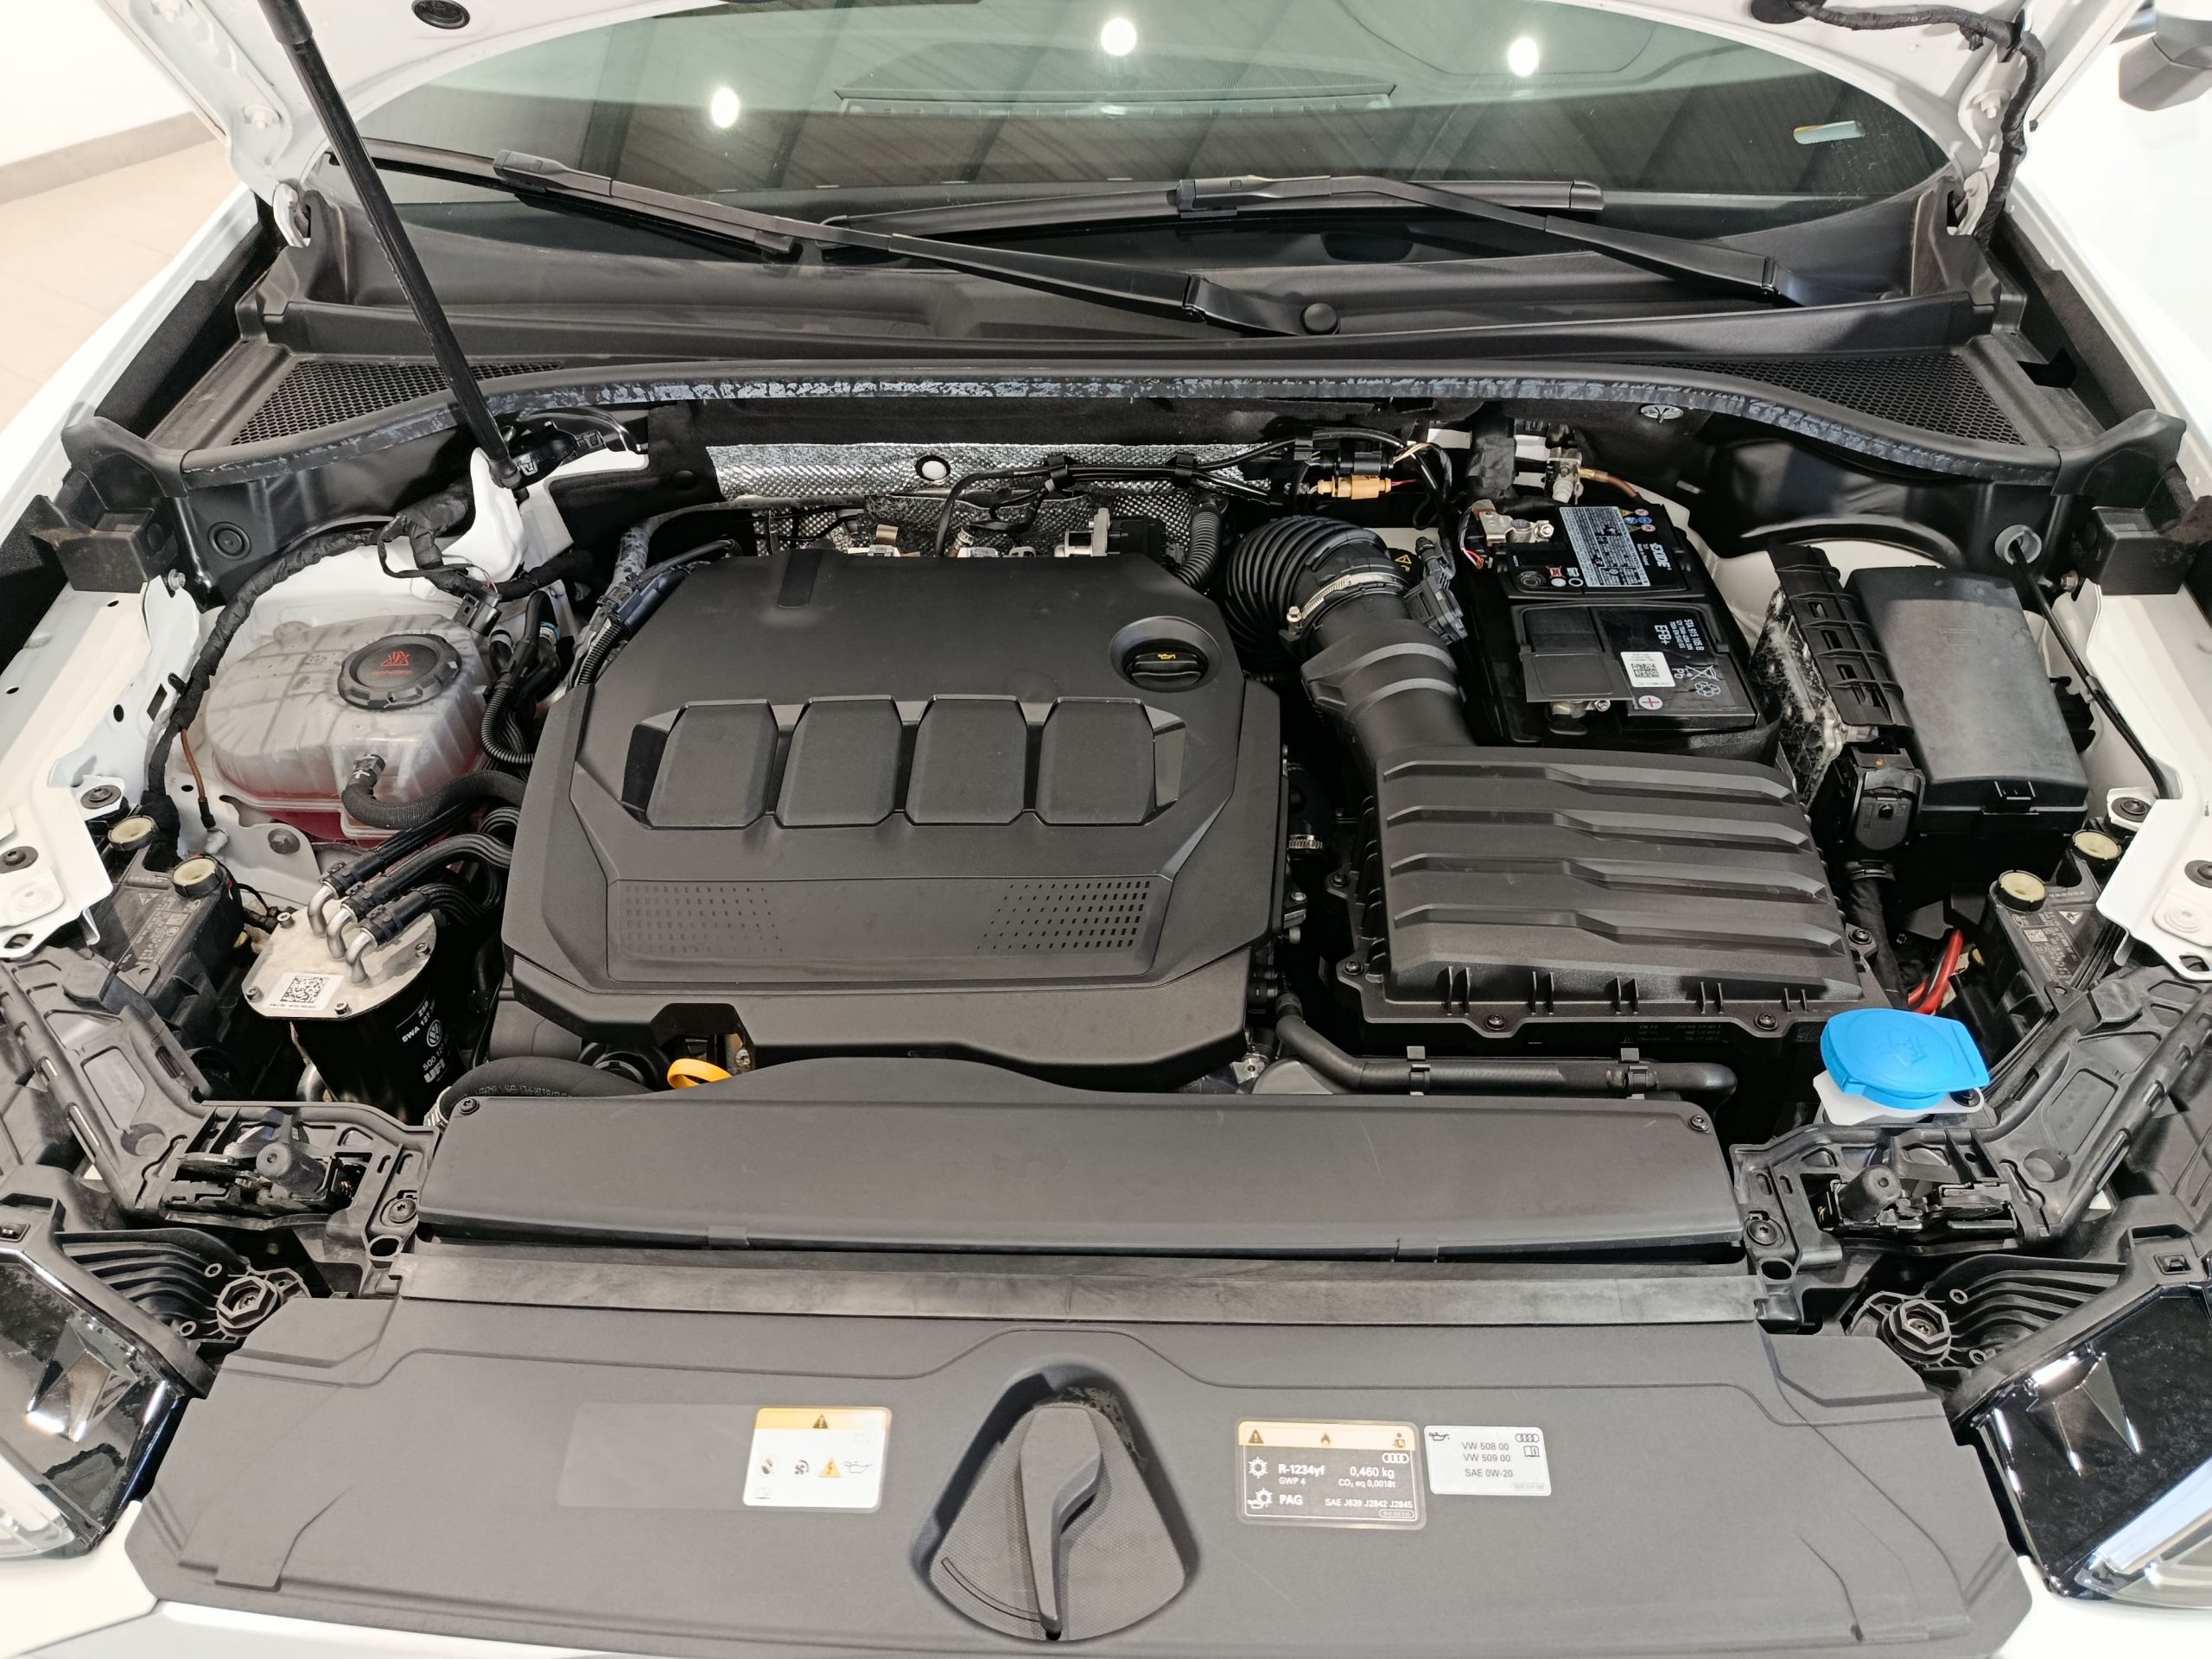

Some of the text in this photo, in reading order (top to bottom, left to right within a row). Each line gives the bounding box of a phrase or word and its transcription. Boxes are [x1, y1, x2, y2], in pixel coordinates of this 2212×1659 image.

[1649, 543, 1671, 568] EXIDE
[1655, 625, 1671, 645] EFB+
[1672, 668, 1685, 679] Pb
[423, 1058, 446, 1084] UFI
[1480, 1442, 1497, 1451] 508
[1463, 1453, 1479, 1462] VW
[1278, 1464, 1325, 1477] R-1234yf
[1350, 1466, 1395, 1479] 0,460 kg
[1465, 1469, 1514, 1478] SAE 0W-20
[1279, 1495, 1303, 1505] PAG
[1325, 1498, 1413, 1509] SAE J639 J2842 J2845
